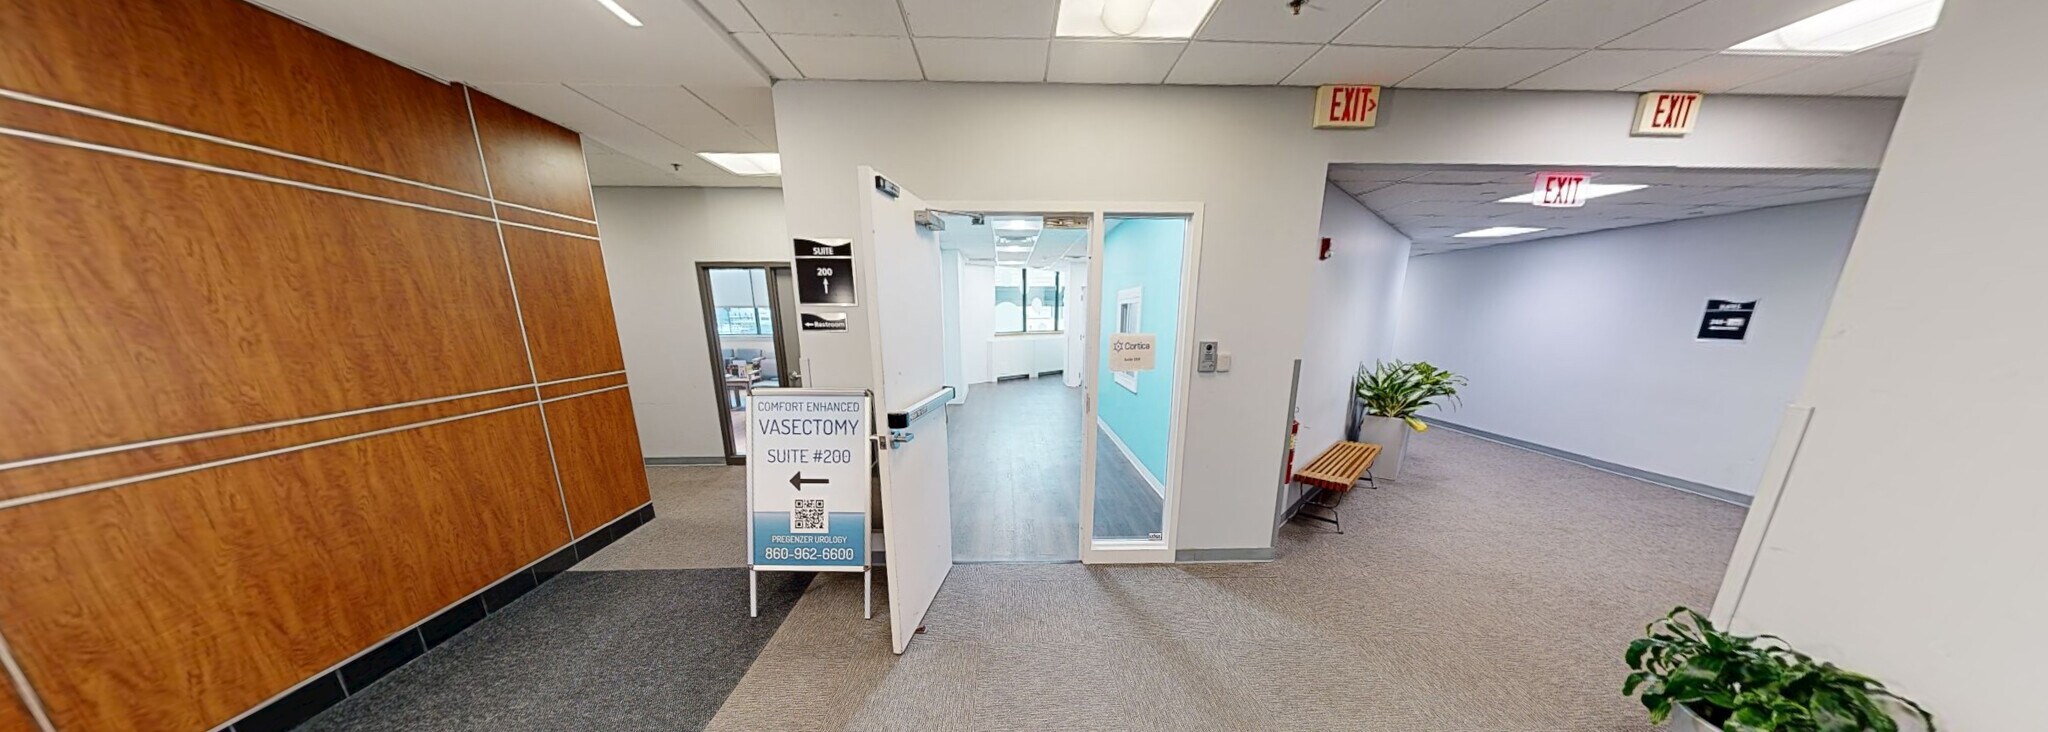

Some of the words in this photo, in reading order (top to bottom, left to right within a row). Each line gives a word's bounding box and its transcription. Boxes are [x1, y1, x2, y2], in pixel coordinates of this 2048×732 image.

[1329, 87, 1372, 122] EXIT
[1651, 94, 1697, 129] EXIT
[1543, 176, 1583, 204] EXIT
[812, 247, 834, 255] SUITE
[816, 267, 833, 276] 200
[1124, 341, 1150, 350] Cortica
[758, 401, 804, 412] COMFORT
[806, 401, 860, 412] ENHANCED
[758, 419, 860, 435] VASECTOMY
[767, 449, 809, 464] SUITE
[812, 449, 851, 464] #200
[771, 535, 814, 543] PREGENZER
[814, 535, 848, 543] UROLOGY
[765, 547, 854, 560] 860-962-6600
